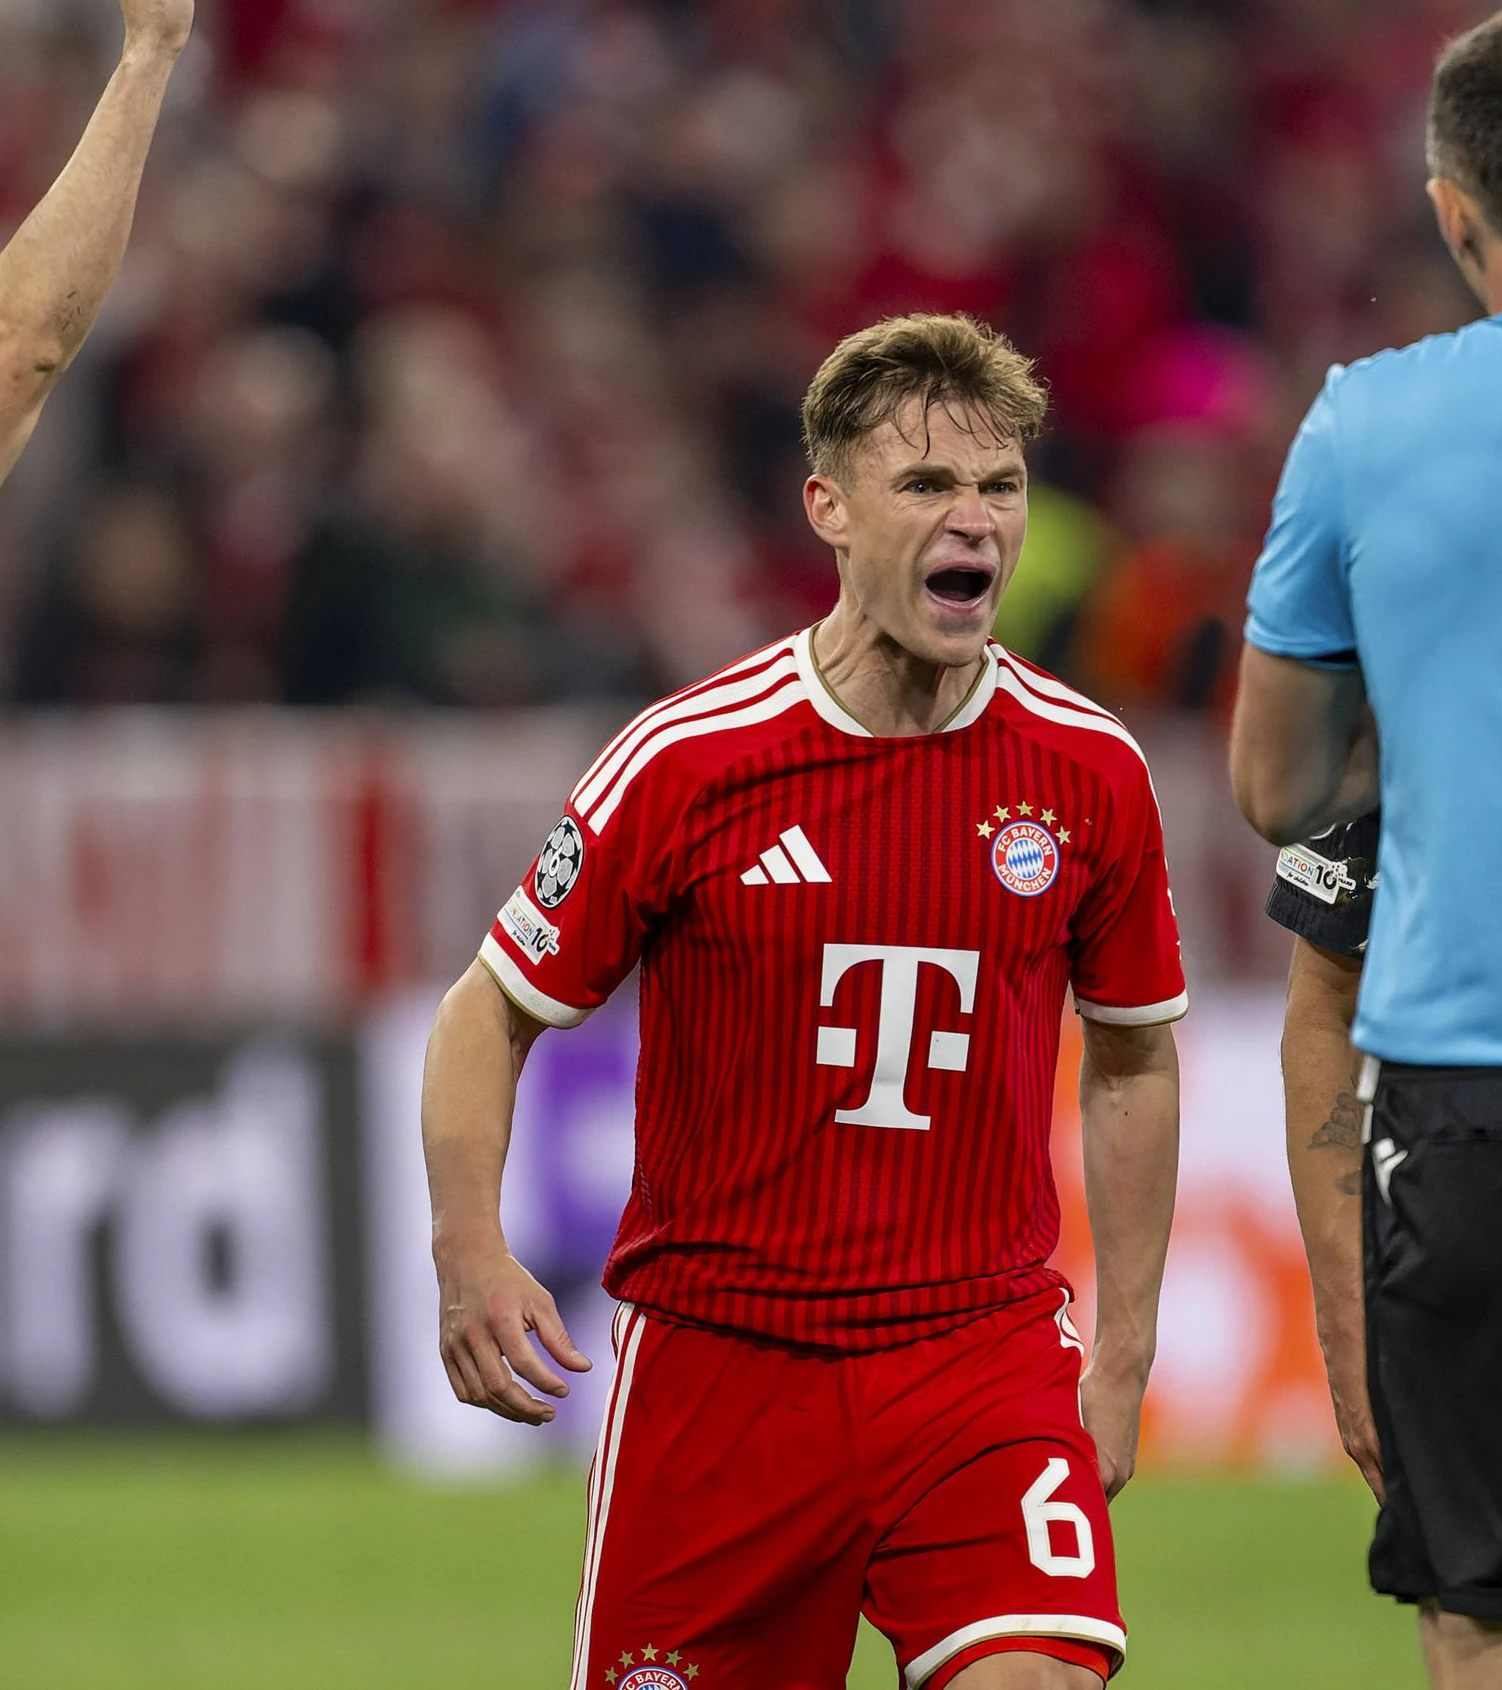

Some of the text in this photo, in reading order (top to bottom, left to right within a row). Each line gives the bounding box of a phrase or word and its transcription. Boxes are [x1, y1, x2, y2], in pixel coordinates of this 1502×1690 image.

[998, 827, 1053, 856] FC BAYERN
[548, 846, 564, 877] 6
[1315, 865, 1337, 890] 10
[816, 943, 980, 1131] T
[1021, 1458, 1095, 1579] 6
